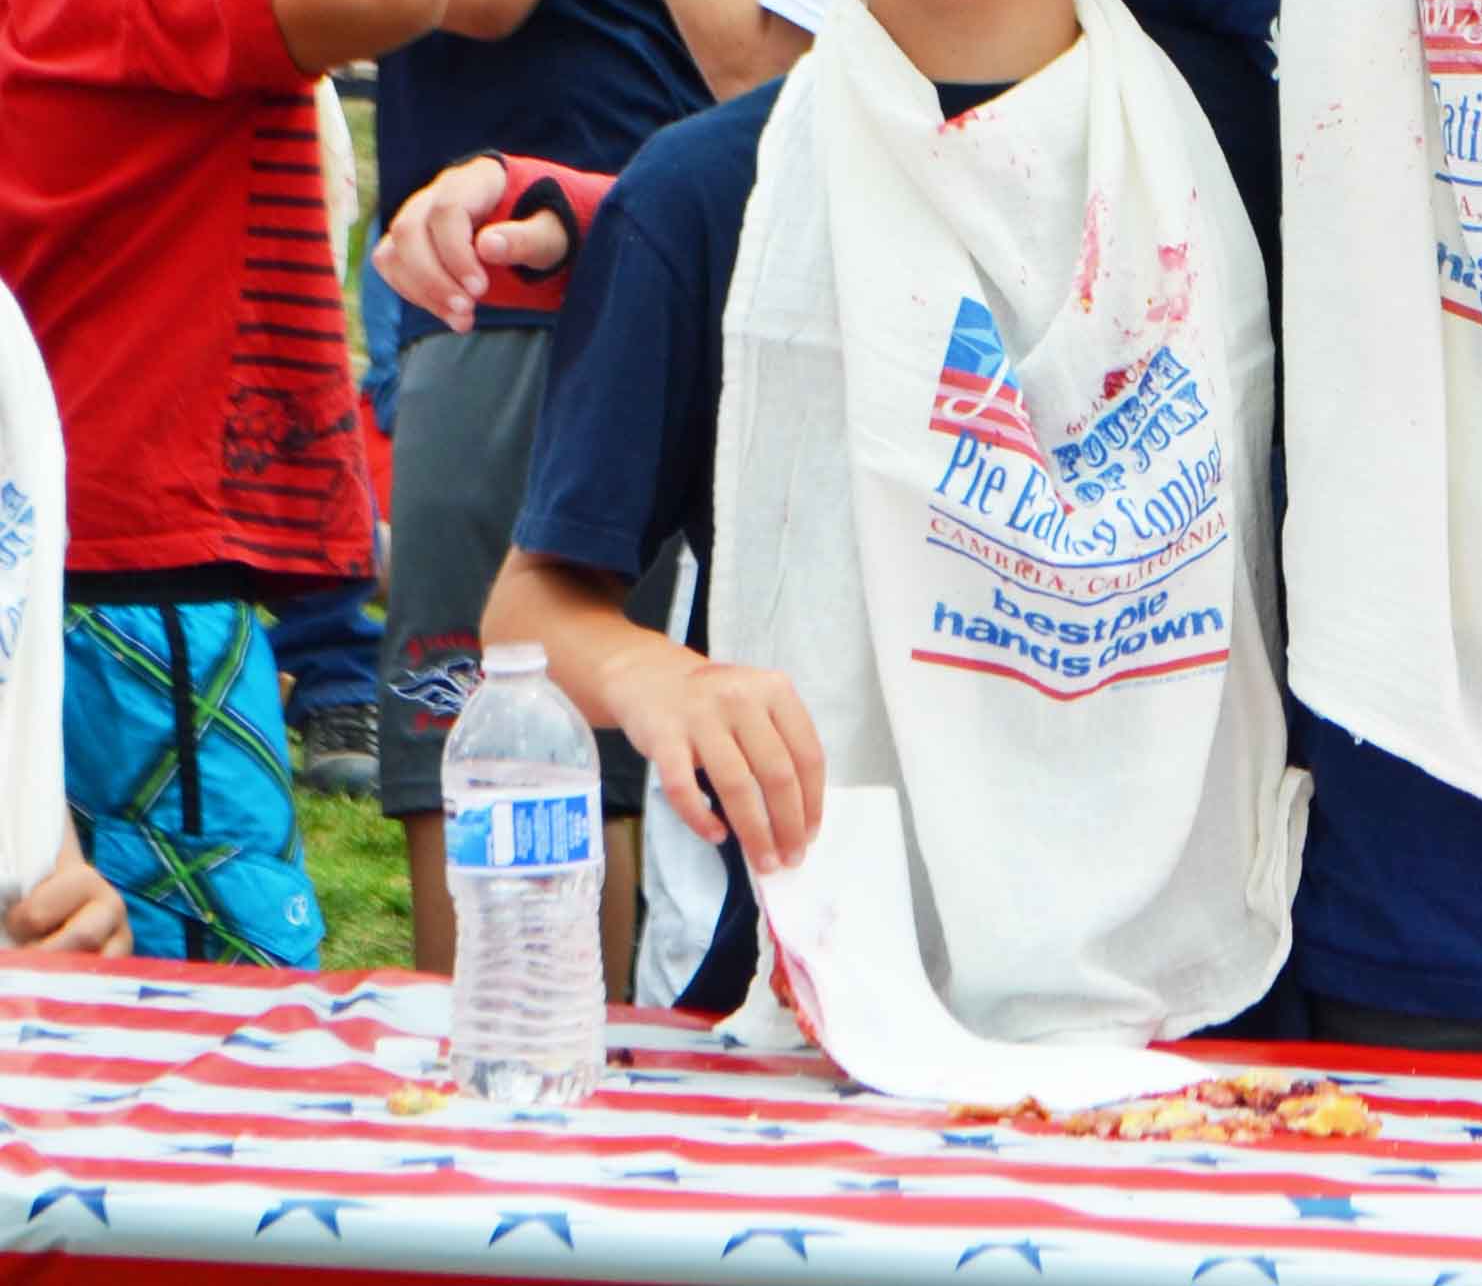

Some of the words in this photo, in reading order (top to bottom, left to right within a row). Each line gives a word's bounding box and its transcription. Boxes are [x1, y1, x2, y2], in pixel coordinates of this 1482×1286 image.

[935, 428, 1006, 515] Pie
[1075, 462, 1127, 503] OF
[1130, 380, 1209, 474] JULY
[930, 518, 1076, 595] CAMBRIA,
[1087, 511, 1227, 595] CALIFORNIA
[932, 601, 1091, 678] hands
[1098, 603, 1225, 668] down
[992, 588, 1109, 645] best
[1109, 589, 1169, 641] pie
